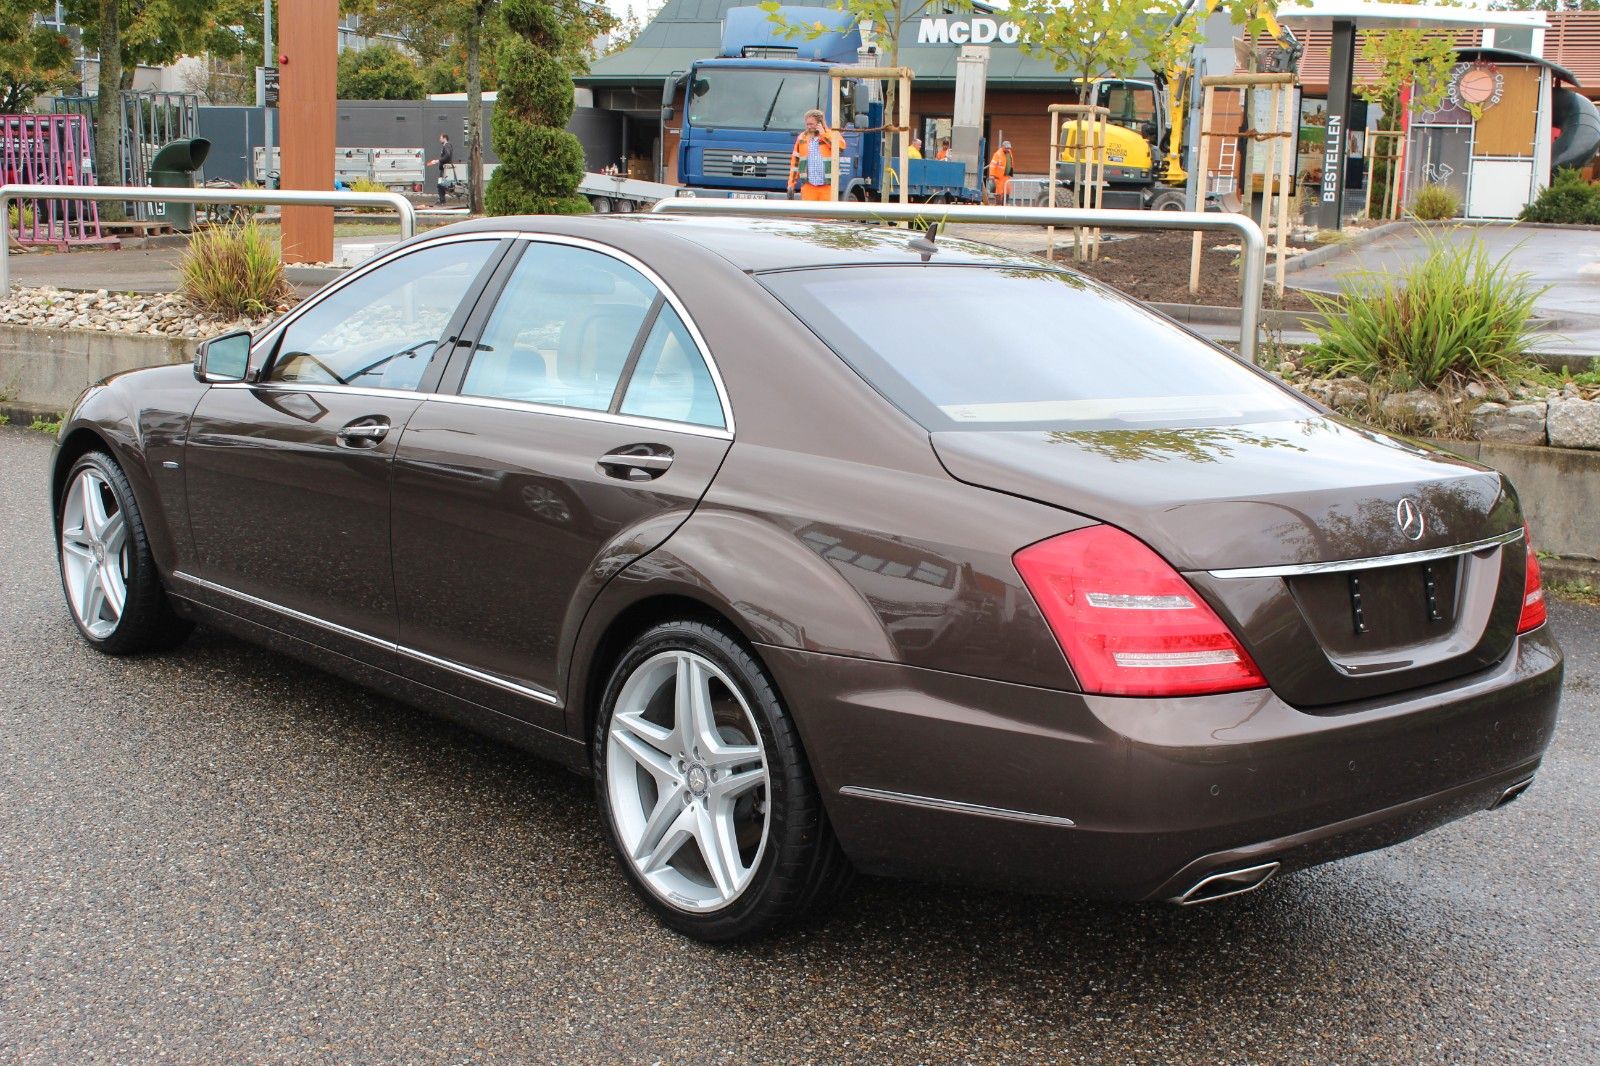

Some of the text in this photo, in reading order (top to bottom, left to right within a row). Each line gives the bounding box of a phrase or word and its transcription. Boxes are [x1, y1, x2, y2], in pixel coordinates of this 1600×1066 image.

[917, 18, 1044, 44] McDo
[1447, 61, 1504, 104] RONALD CLUB
[732, 155, 767, 164] MAN
[1323, 115, 1341, 202] BESTELLEN
